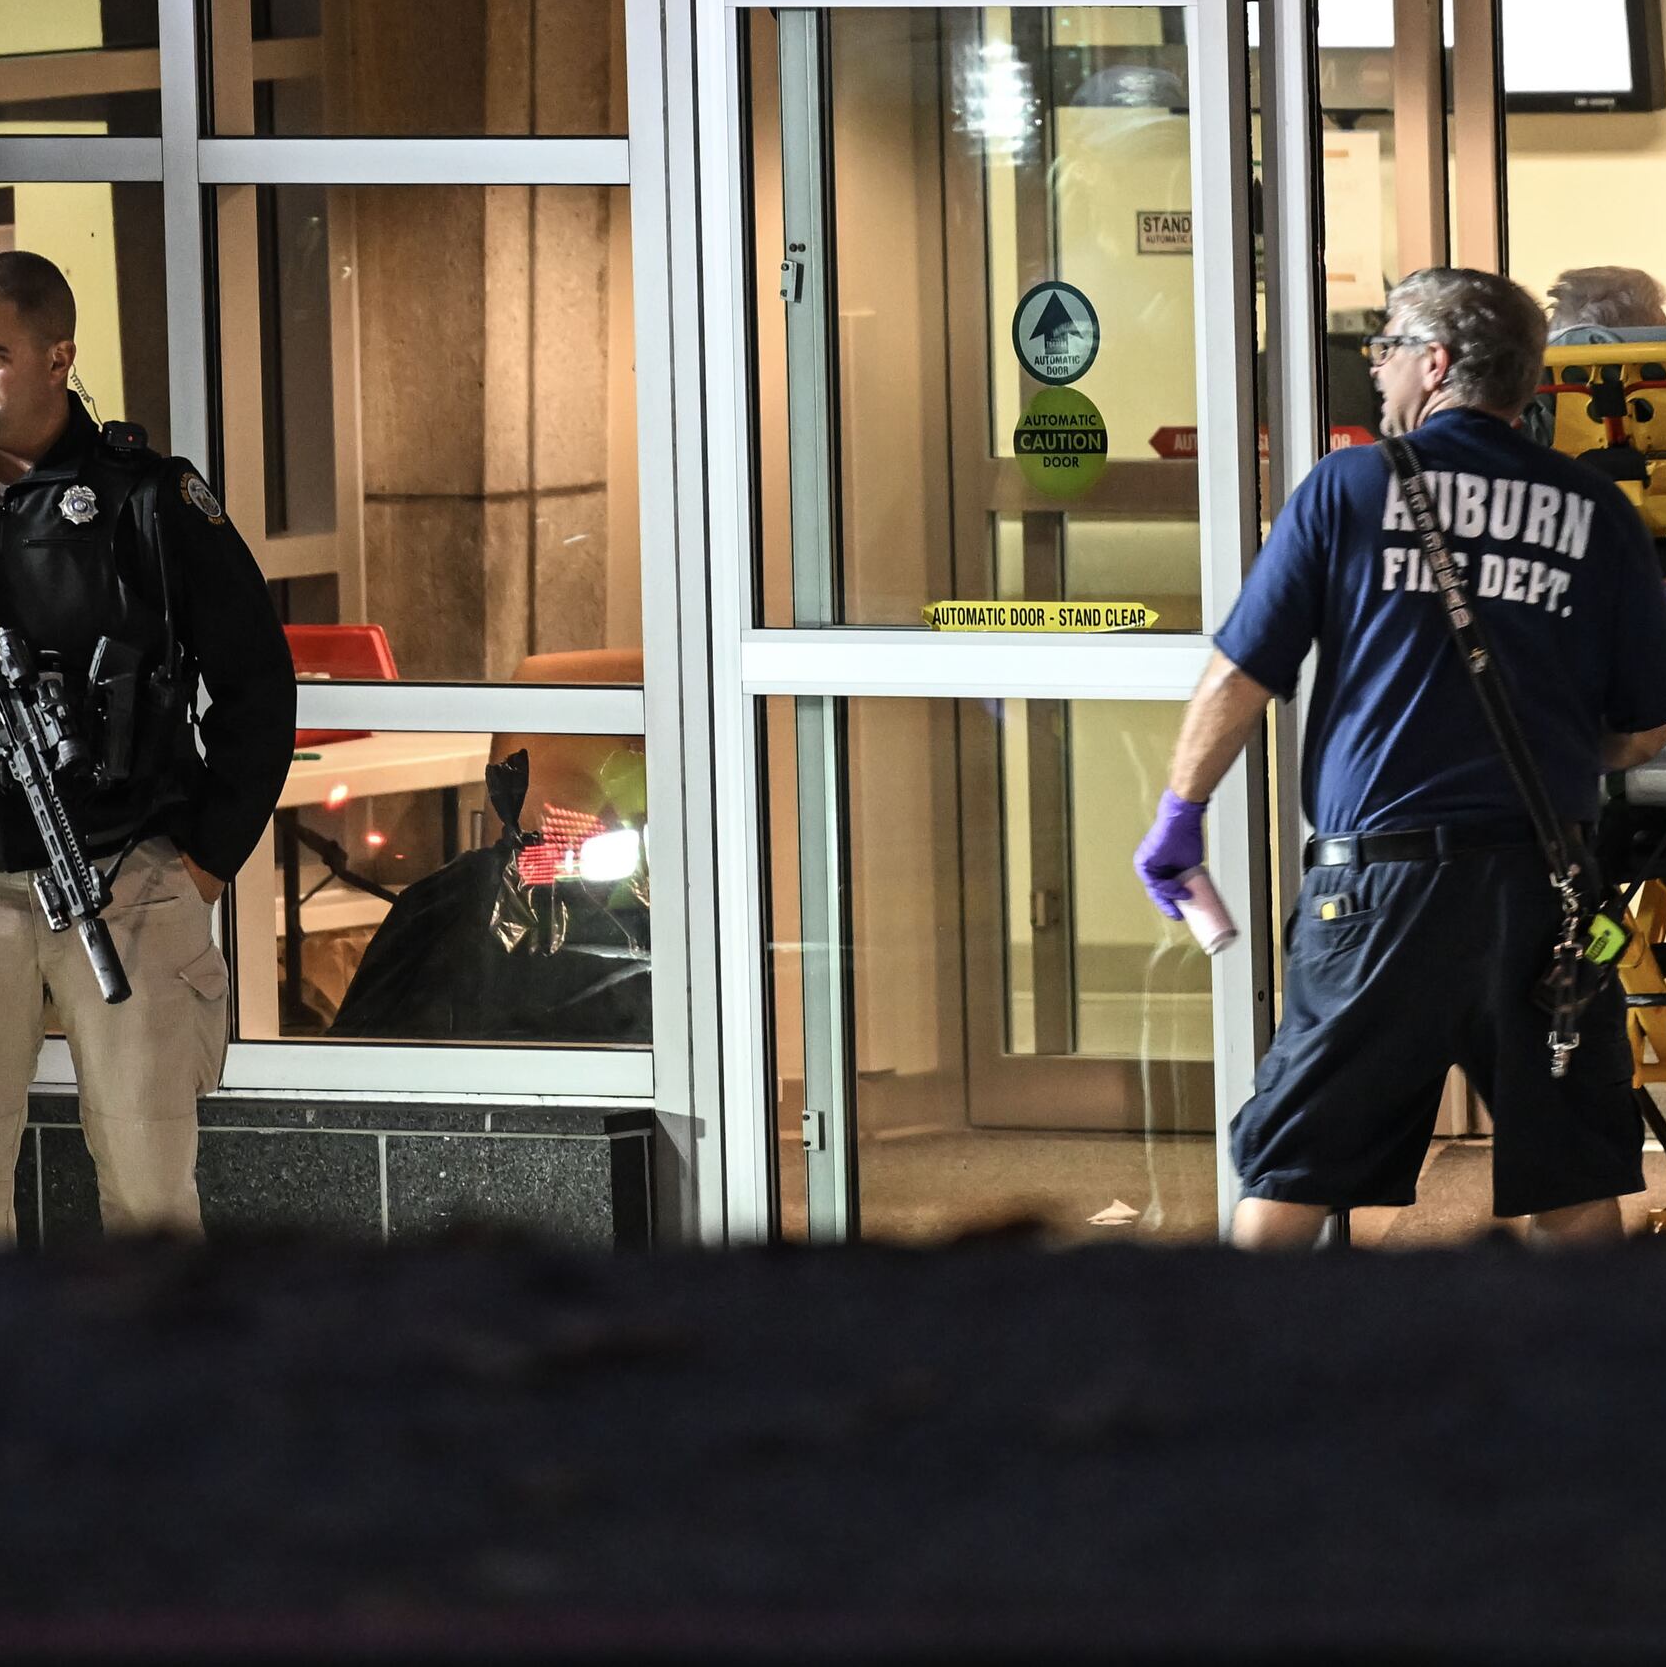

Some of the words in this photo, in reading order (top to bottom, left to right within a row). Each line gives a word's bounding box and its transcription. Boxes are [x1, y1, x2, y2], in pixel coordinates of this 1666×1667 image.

[1143, 216, 1191, 233] STAND
[1034, 355, 1081, 366] AUTOMATIC
[1046, 365, 1069, 376] DOOR
[1024, 414, 1097, 427] AUTOMATIC
[1019, 433, 1101, 451] CAUTION
[1043, 456, 1080, 468] DOOR
[1383, 469, 1596, 560] AUBURN
[1477, 553, 1573, 618] DEPT.
[933, 607, 1007, 626] AUTOMATIC
[1011, 608, 1045, 626] DOOR
[1059, 609, 1101, 627] STAND
[1105, 608, 1146, 627] CLEAR
